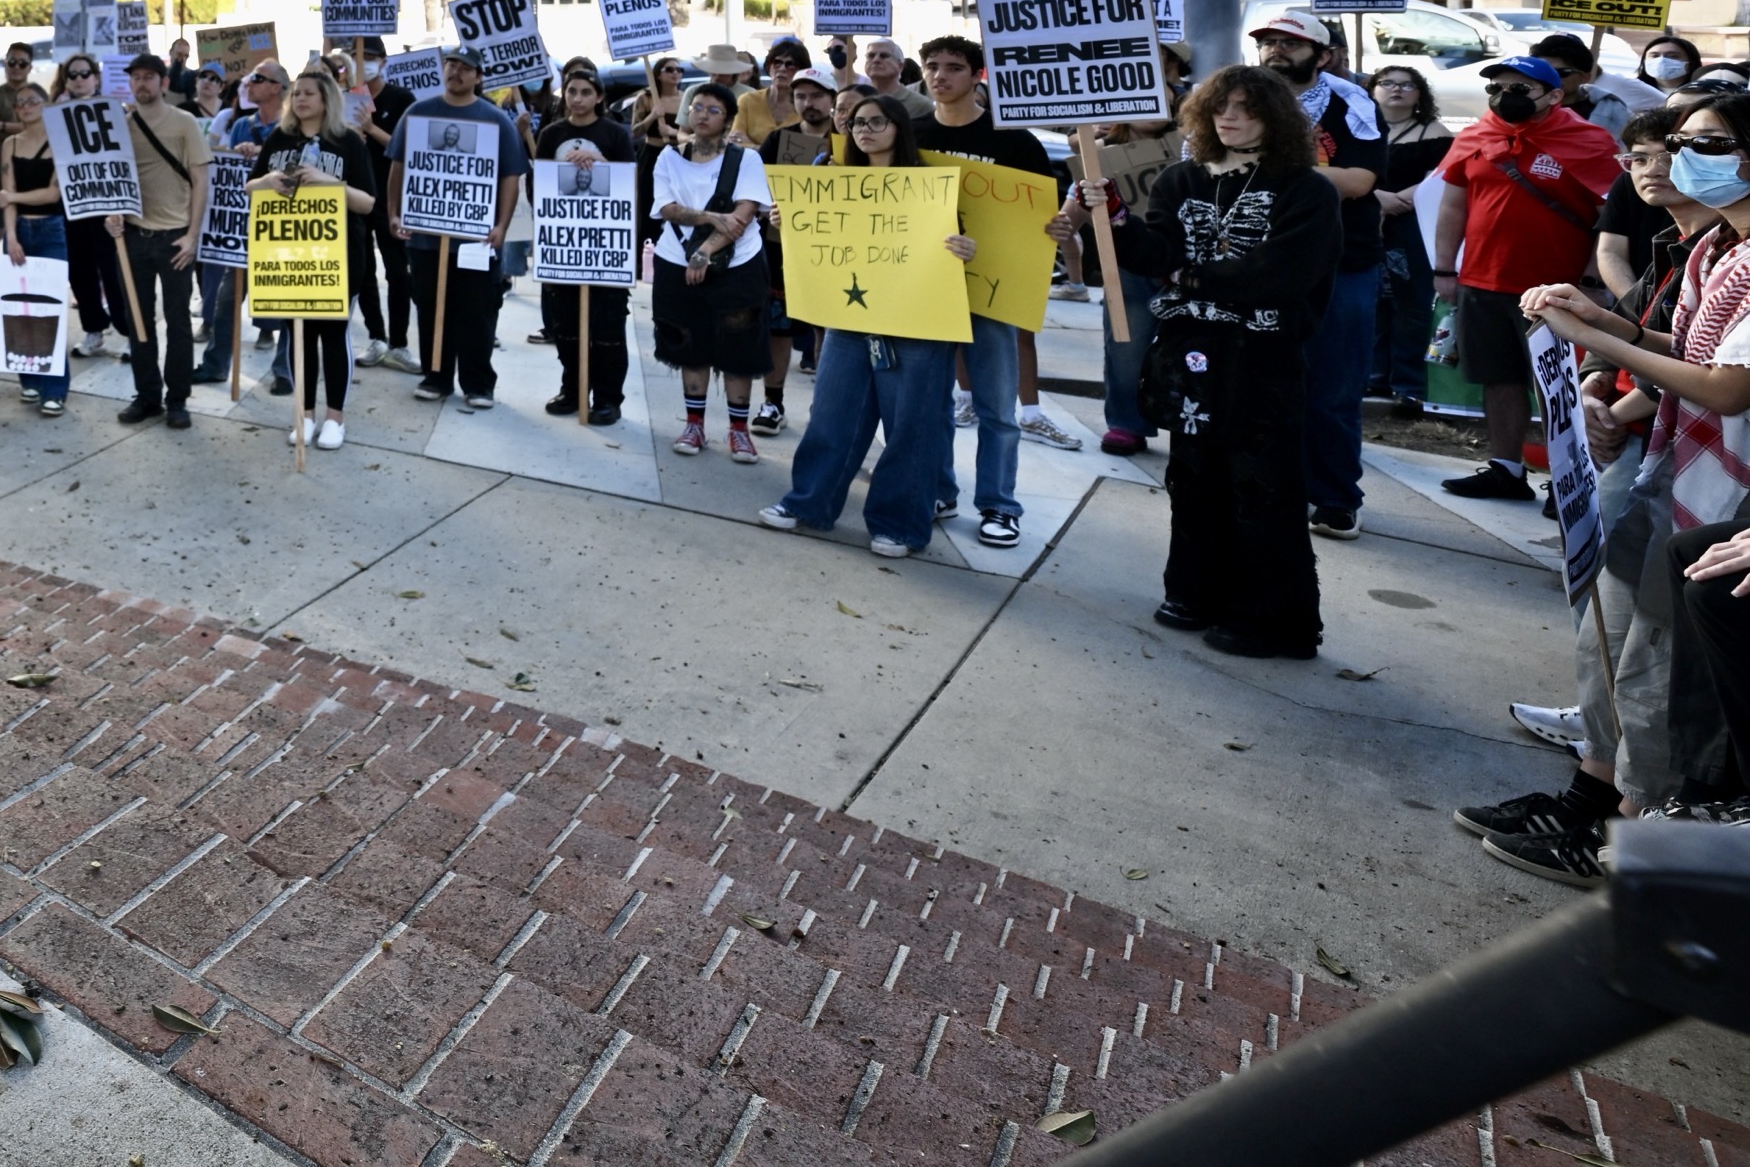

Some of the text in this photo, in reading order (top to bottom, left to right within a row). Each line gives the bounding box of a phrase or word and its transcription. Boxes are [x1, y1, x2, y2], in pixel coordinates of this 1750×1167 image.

[325, 5, 395, 22] COMMUNITIES
[818, 8, 886, 17] INMIGRANTES!
[1164, 0, 1172, 16] A
[1581, 13, 1613, 22] SOCIALISM
[1623, 16, 1659, 25] LIBERATION
[1596, 2, 1663, 15] OUT!
[610, 24, 628, 33] PARA
[630, 20, 652, 30] TODOS
[612, 26, 669, 43] INMIGRANTES!
[491, 35, 540, 62] TERROR
[993, 37, 1151, 66] RENEE
[481, 54, 543, 78] NOW!
[995, 61, 1156, 98] NICOLE GOOD
[1001, 99, 1156, 118] PARTY FOR SOCIALISM & LIBERATION
[62, 102, 121, 155] ICE
[67, 160, 132, 182] OUT OF OUR
[408, 151, 495, 178] JUSTICE FOR
[214, 188, 246, 209] ROSS
[406, 175, 493, 205] ALEX PRETTI
[768, 173, 954, 206] IMMIGRANT
[962, 171, 1043, 209] OUT
[257, 199, 338, 218] ¡DERECHOS
[408, 197, 489, 222] KILLED BY CBP
[538, 198, 632, 221] JUSTICE FOR
[255, 219, 338, 241] PLENOS
[792, 211, 908, 234] GET THE
[538, 225, 631, 250] ALEX PRETTI
[254, 261, 340, 271] PARA TODOS LOS
[541, 248, 628, 267] KILLED BY CBP
[810, 245, 908, 266] JOB DONE
[254, 274, 340, 286] INMIGRANTES!
[1556, 471, 1576, 503] PARA
